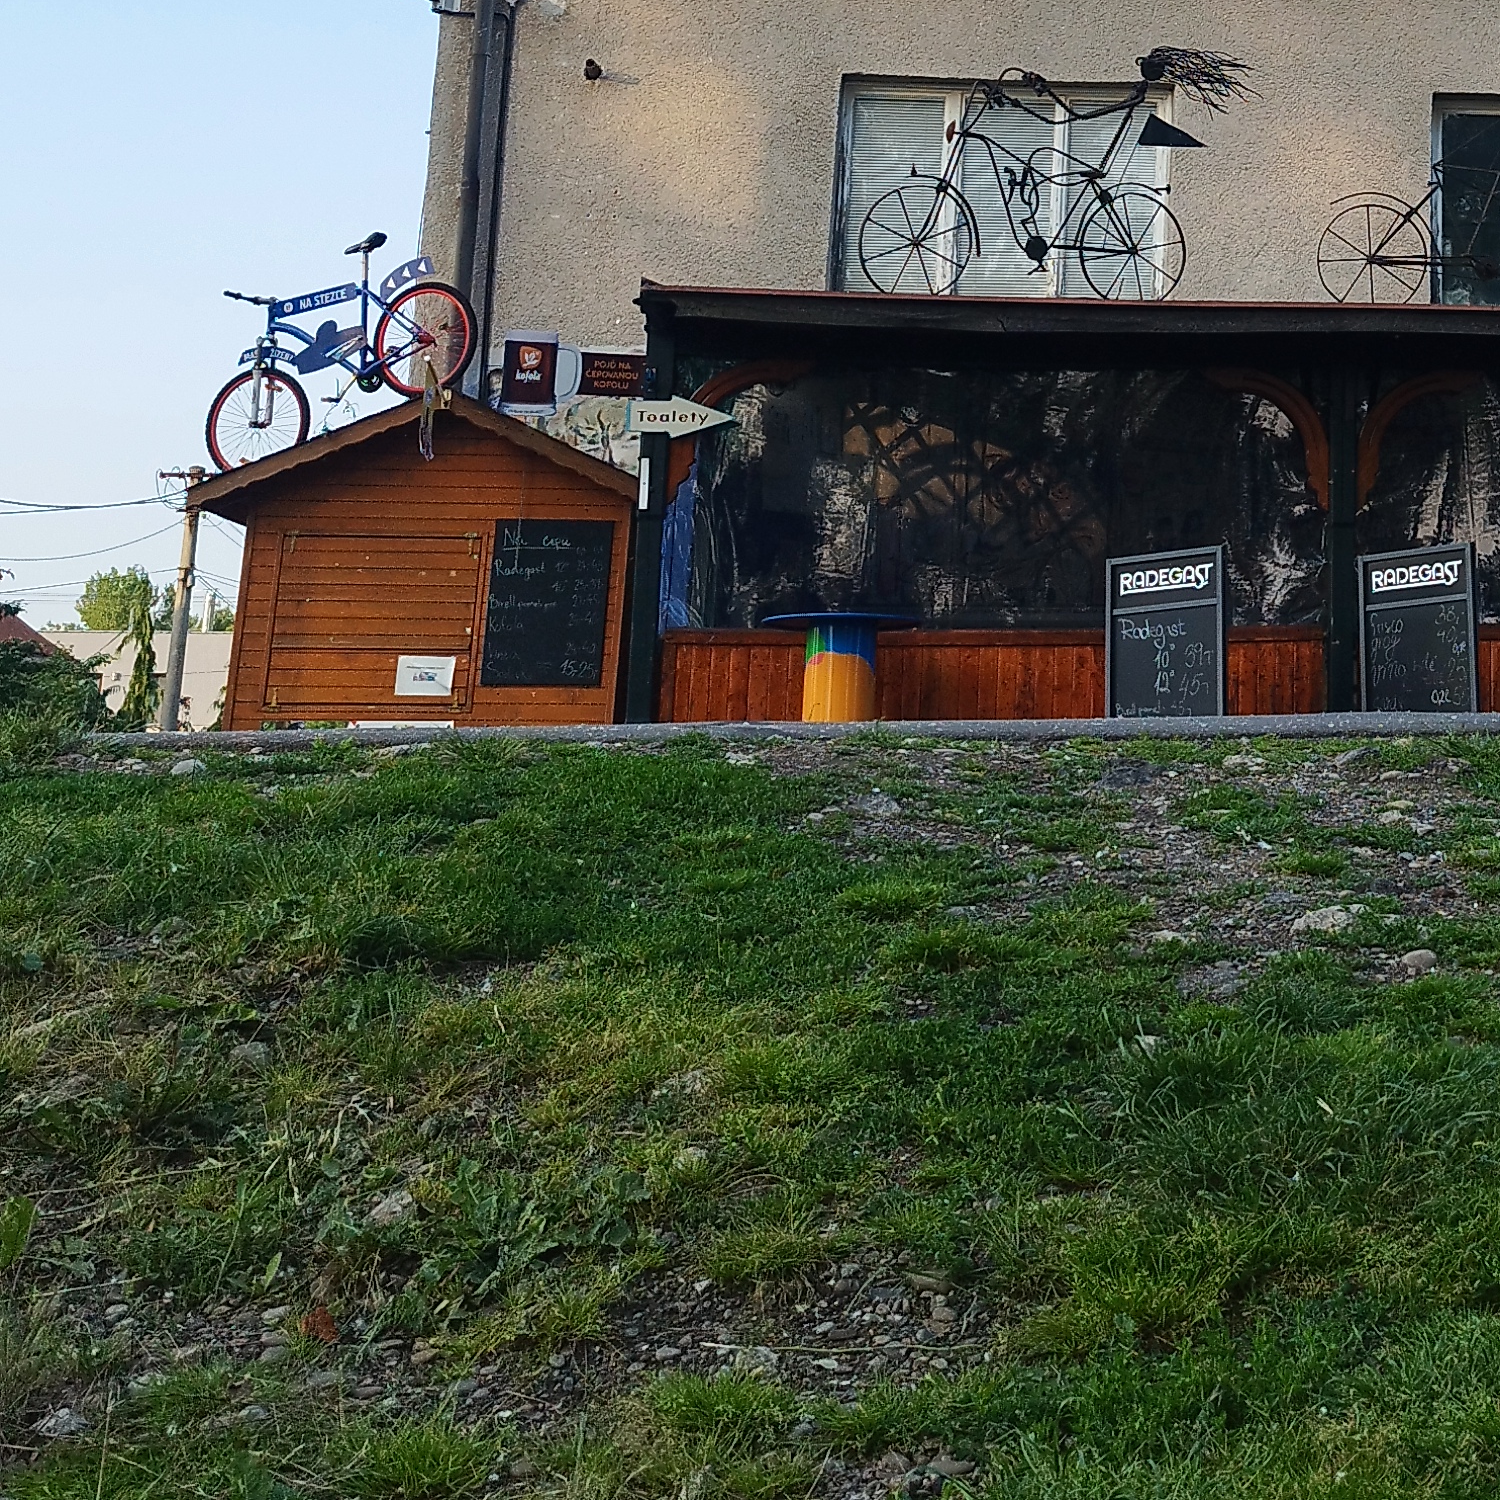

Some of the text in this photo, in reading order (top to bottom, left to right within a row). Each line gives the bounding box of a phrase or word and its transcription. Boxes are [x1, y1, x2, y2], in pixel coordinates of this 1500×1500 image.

[300, 288, 347, 310] NA STEZCE
[618, 361, 632, 371] NA
[515, 369, 542, 384] kofola
[593, 381, 629, 390] KOFOLU
[637, 410, 709, 426] Toalety
[1120, 562, 1213, 596] RADEGAST
[1371, 560, 1462, 593] RADEGAST
